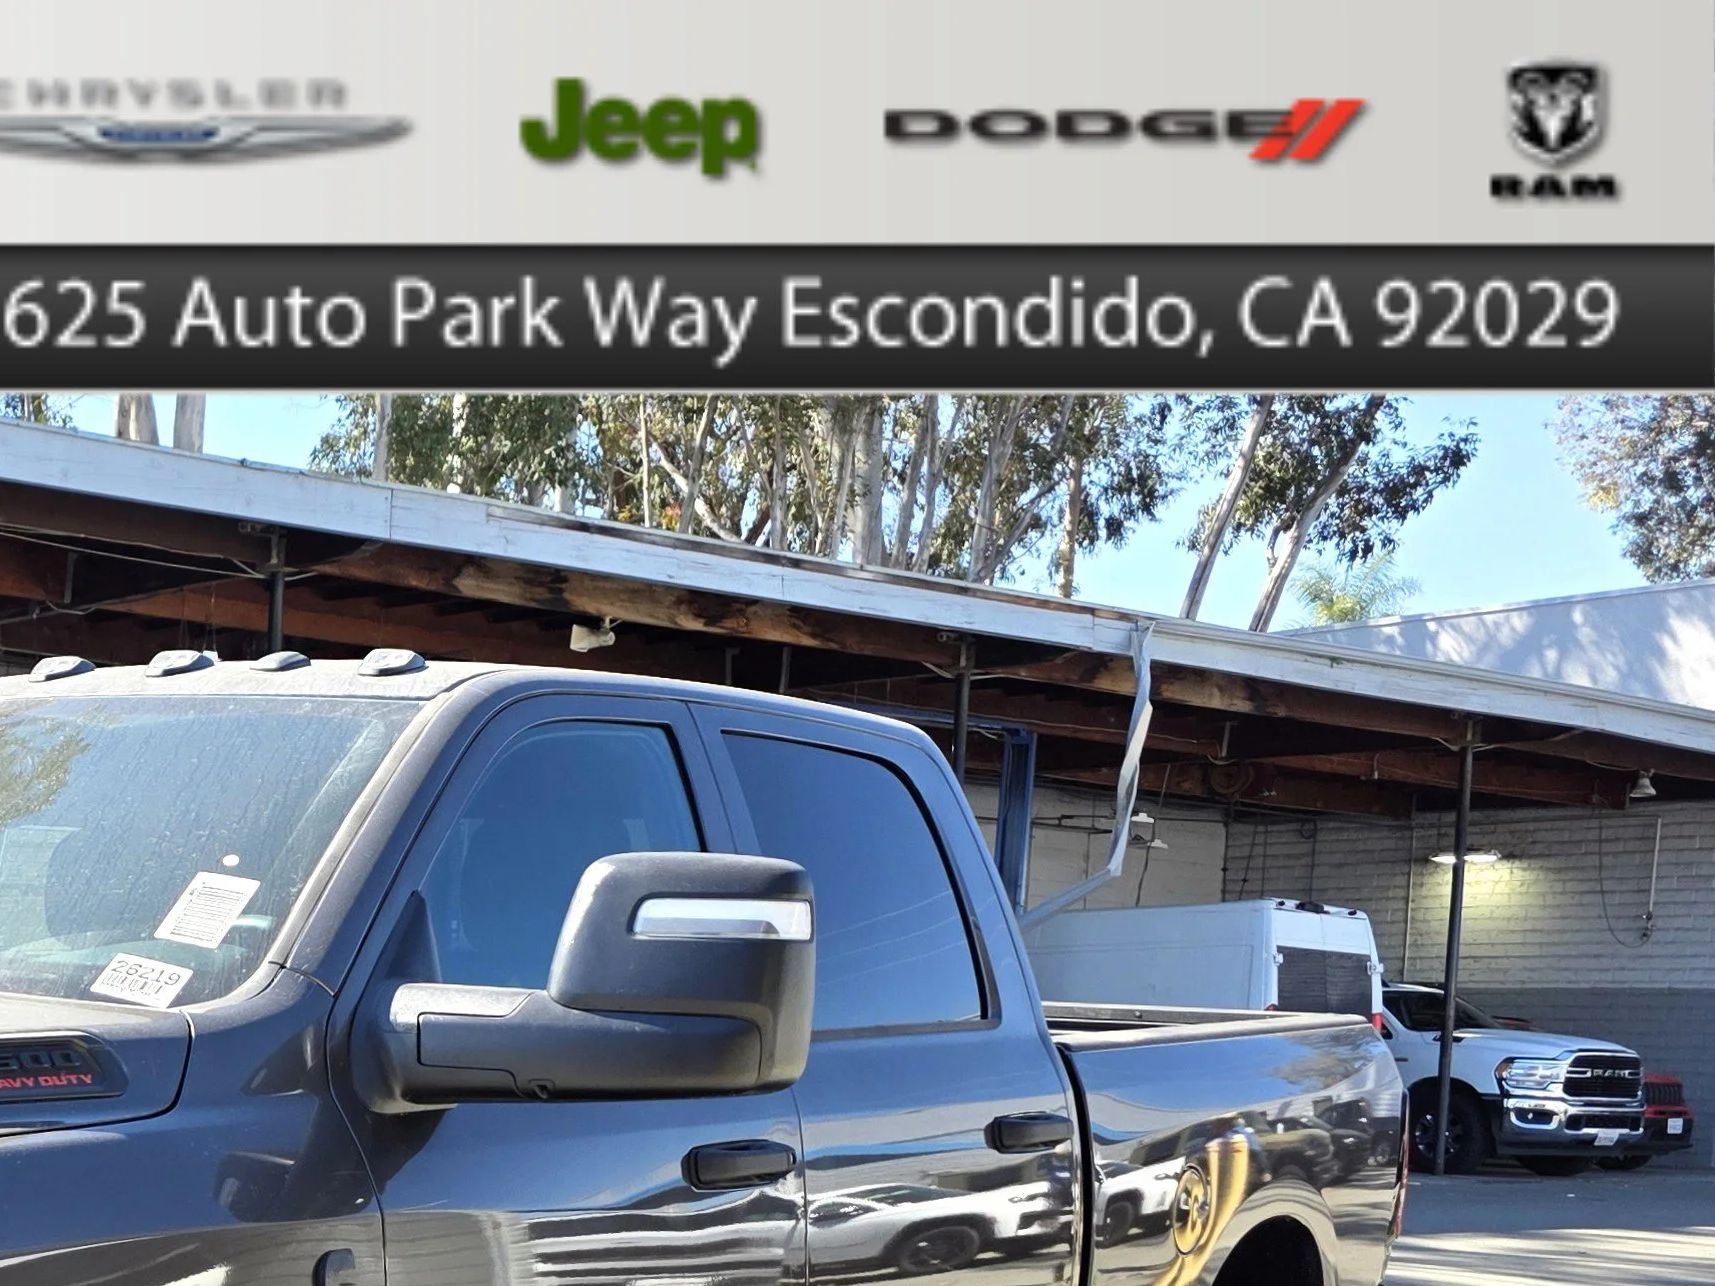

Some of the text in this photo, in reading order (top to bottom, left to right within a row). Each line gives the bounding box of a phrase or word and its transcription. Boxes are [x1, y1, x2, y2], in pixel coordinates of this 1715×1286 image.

[111, 960, 181, 986] 26219
[39, 1073, 93, 1088] DUTY
[1592, 1069, 1628, 1078] RAM
